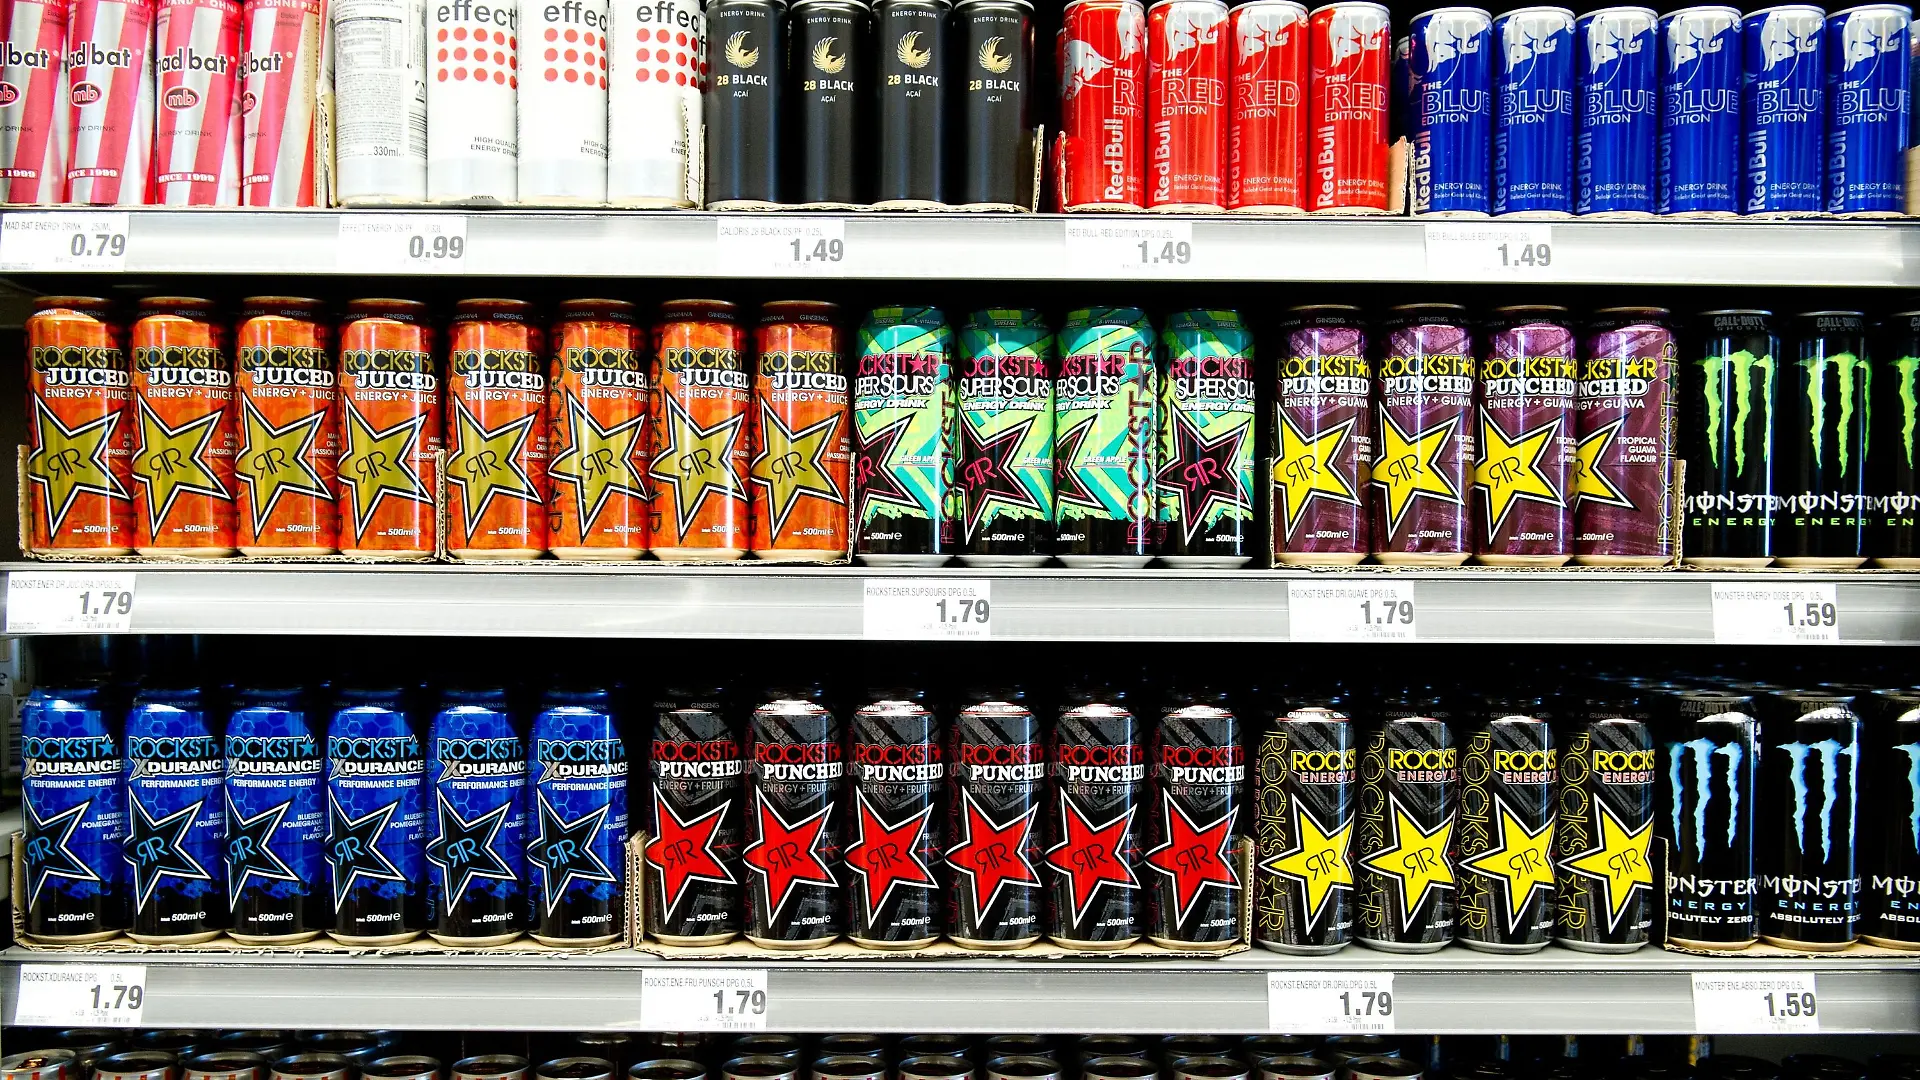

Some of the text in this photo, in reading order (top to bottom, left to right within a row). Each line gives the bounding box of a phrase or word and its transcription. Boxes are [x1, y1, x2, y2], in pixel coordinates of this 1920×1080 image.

[720, 10, 766, 18] ENERGY DRINK
[891, 10, 937, 19] ENERGY DRINK
[8, 43, 49, 68] bat
[91, 44, 131, 68] bat
[188, 48, 228, 74] bat
[250, 51, 282, 73] bat
[1162, 68, 1182, 79] THE
[1325, 74, 1347, 84] THE
[716, 74, 768, 87] 28 BLACK
[804, 79, 854, 92] 28 BLACK
[887, 74, 939, 87] 28 BLACK
[969, 79, 1020, 92] 28 BLACK
[1422, 80, 1442, 92] THE
[1161, 77, 1226, 107] RED
[1500, 82, 1518, 93] THE
[1325, 83, 1388, 112] RED
[1421, 89, 1491, 116] BLUE
[1500, 89, 1572, 116] BLUE
[1161, 104, 1207, 117] EDITION
[1325, 111, 1372, 123] EDITION
[1421, 114, 1469, 126] EDITION
[1500, 114, 1545, 128] EDITION
[474, 136, 493, 144] HIGH
[470, 144, 500, 154] ENERGY
[1243, 176, 1293, 184] ENERGY DRINK
[1510, 183, 1562, 192] ENERGY DRINK
[1674, 183, 1728, 192] ENERGY DRINK
[35, 222, 60, 231] ENERGY
[761, 227, 781, 236] BLACK
[70, 233, 126, 257] 0.79
[409, 235, 464, 259] 0.99
[790, 238, 844, 262] 1.49
[1137, 240, 1192, 264] 1.49
[1497, 243, 1551, 267] 1.49
[46, 367, 130, 387] JUICED
[149, 368, 232, 388] JUICED
[253, 367, 334, 387] JUICED
[356, 371, 437, 391] JUICED
[466, 370, 544, 390] JUICED
[1283, 376, 1370, 395] PUNCHED
[1385, 375, 1473, 395] PUNCHED
[45, 388, 93, 399] ENERGY
[147, 388, 232, 400] ENERGY JUICE
[252, 388, 299, 398] ENERGY
[355, 391, 437, 404] ENERGY JUICE
[963, 400, 1046, 411] ENERGY DRINK
[1285, 396, 1326, 408] ENERGY
[1387, 395, 1472, 407] ENERGY GUAVA
[1487, 398, 1574, 410] ENERGY GUAVA
[1617, 436, 1657, 445] TROPICAL
[1628, 446, 1657, 454] GUAVA
[1620, 454, 1657, 463] FLAVOUR
[1693, 518, 1776, 527] ENERGY
[948, 588, 961, 597] DPG
[1370, 589, 1383, 599] DPG
[1714, 591, 1745, 601] MONSTER
[1746, 591, 1770, 600] ENERGY
[79, 590, 133, 615] 1.79
[936, 598, 990, 624] 1.79
[1360, 600, 1414, 625] 1.79
[1783, 602, 1837, 627] 1.59
[24, 757, 121, 777] XDURANCE
[227, 757, 322, 778] XDURANCE
[659, 760, 743, 779] PUNCHED
[763, 762, 844, 781] PUNCHED
[863, 763, 944, 782] PUNCHED
[1301, 771, 1349, 782] ENERGY
[1399, 770, 1448, 781] ENERGY
[1604, 772, 1650, 783] ENERGY
[31, 777, 117, 789] PERFORMANCE ENERGY
[233, 777, 316, 788] PERFORMANCE ENERGY
[339, 777, 421, 789] PERFORMANCE ENERGY
[659, 779, 724, 791] ENERGY FRUIT
[762, 782, 798, 793] ENERGY
[862, 783, 928, 794] ENERGY FRUIT
[1778, 899, 1859, 912] ENERGY
[1727, 914, 1753, 924] ZERO
[1770, 912, 1843, 925] ABSOLUTELY
[84, 973, 97, 982] DPG
[726, 978, 740, 987] DPG
[1695, 981, 1726, 990] MONSTER
[1777, 981, 1790, 990] DPG
[90, 984, 143, 1010] 1.79
[713, 989, 766, 1014] 1.79
[1339, 991, 1393, 1016] 1.79
[1763, 992, 1817, 1017] 1.59
